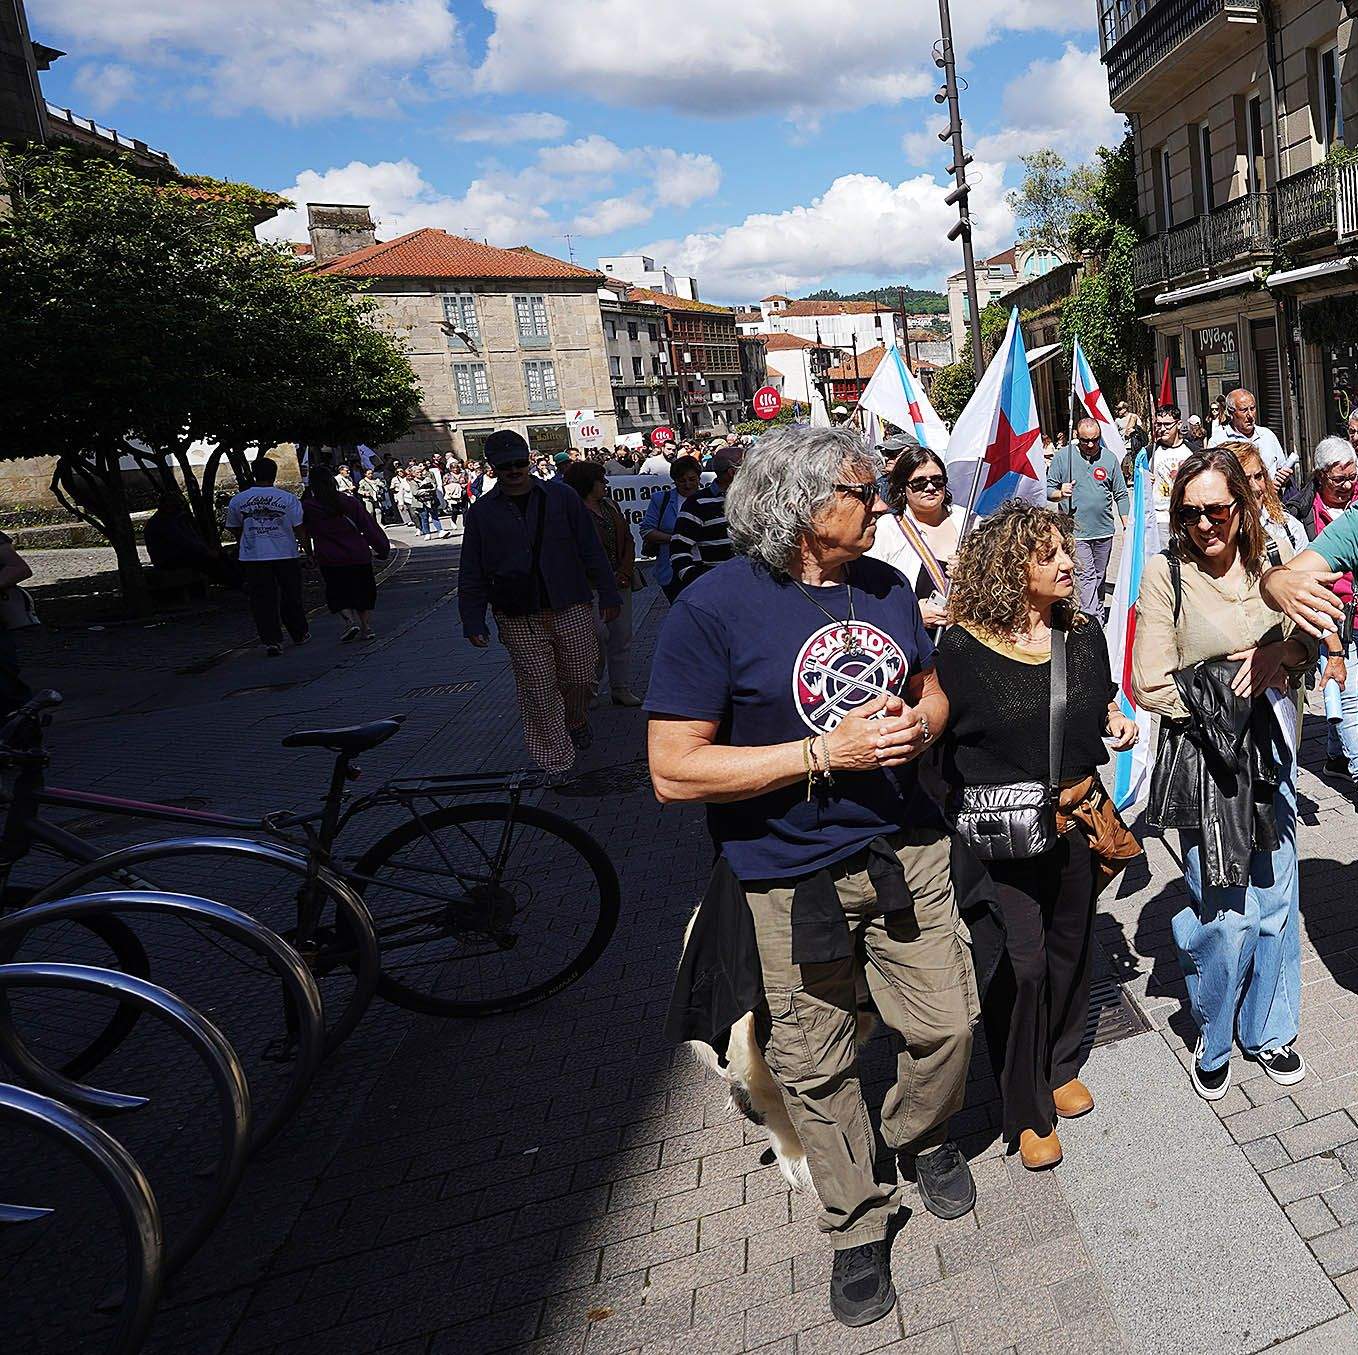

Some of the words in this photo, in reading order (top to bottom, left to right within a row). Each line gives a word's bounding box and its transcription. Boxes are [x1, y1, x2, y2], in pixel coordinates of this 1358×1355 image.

[1221, 331, 1235, 352] 36
[759, 393, 777, 407] CIG
[581, 425, 600, 437] CIG
